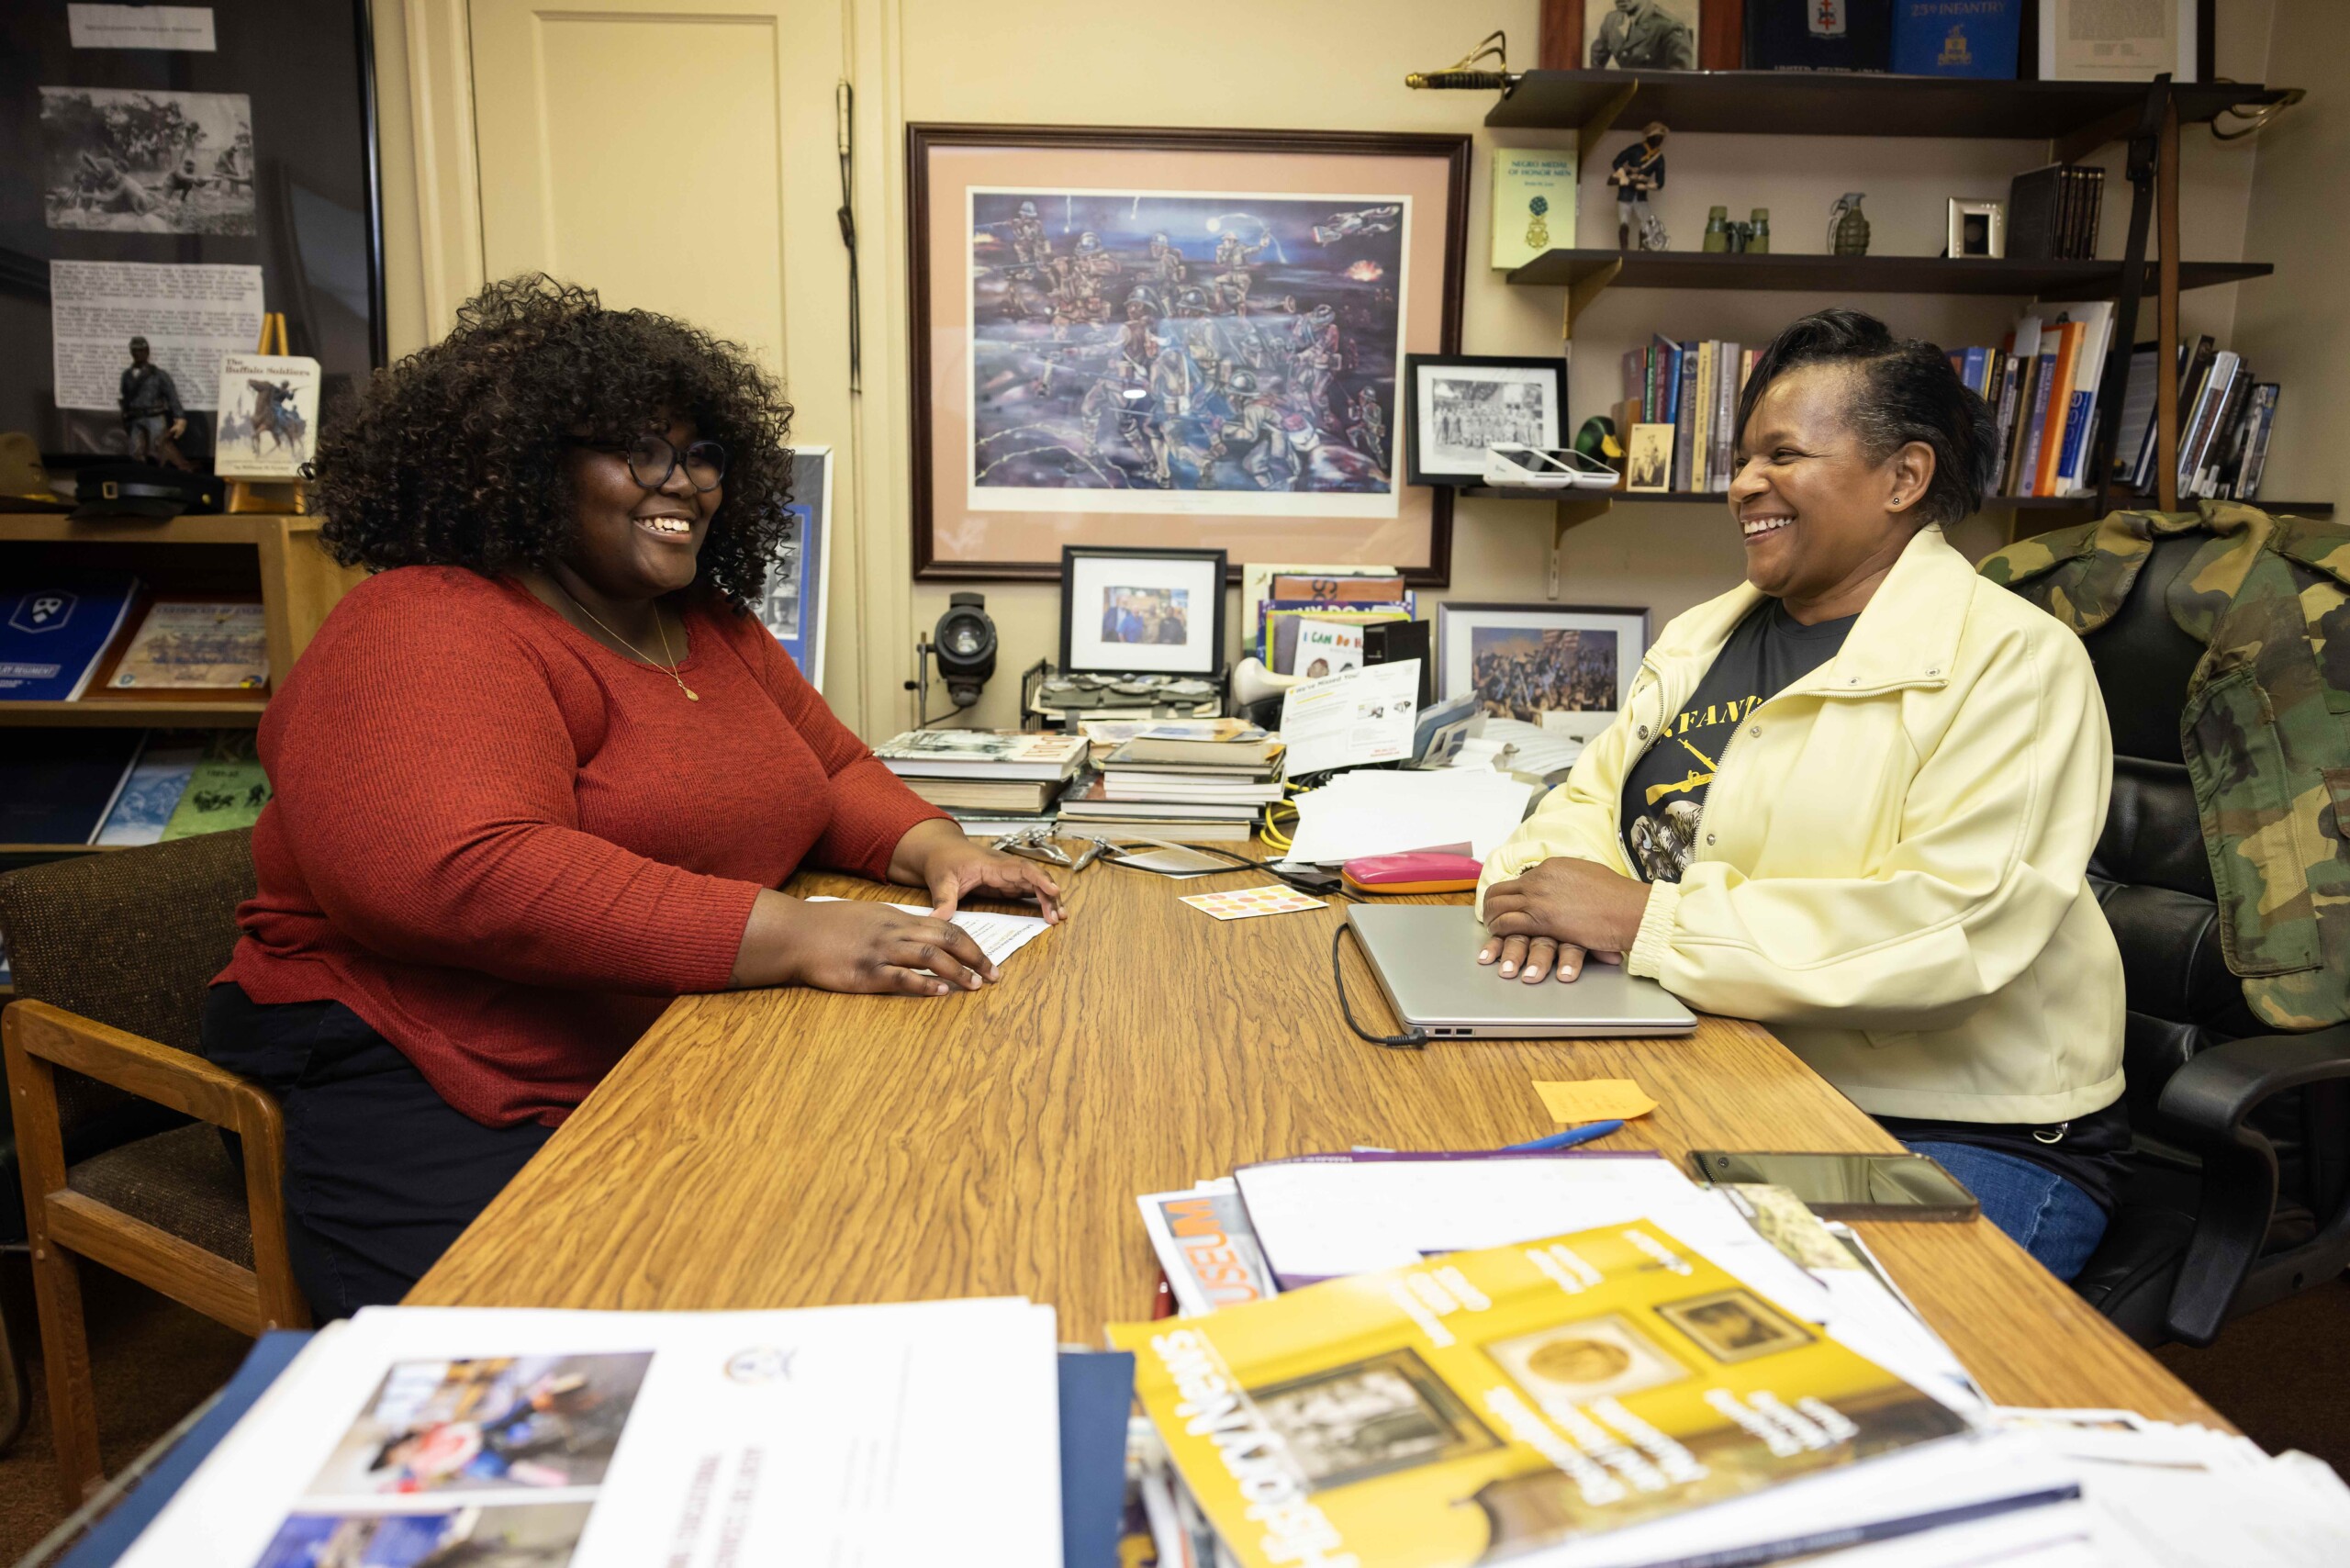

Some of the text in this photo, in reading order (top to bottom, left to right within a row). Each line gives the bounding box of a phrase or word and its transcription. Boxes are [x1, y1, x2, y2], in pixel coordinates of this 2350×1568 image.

[1939, 1, 2006, 15] INFANTRY
[1541, 161, 1568, 169] MEDAL
[1553, 169, 1572, 177] MEN
[227, 357, 243, 366] The
[225, 366, 310, 377] Buffalo Soldiers
[1304, 632, 1308, 642] I
[1311, 632, 1332, 644] CAN
[1663, 695, 1763, 738] FANT
